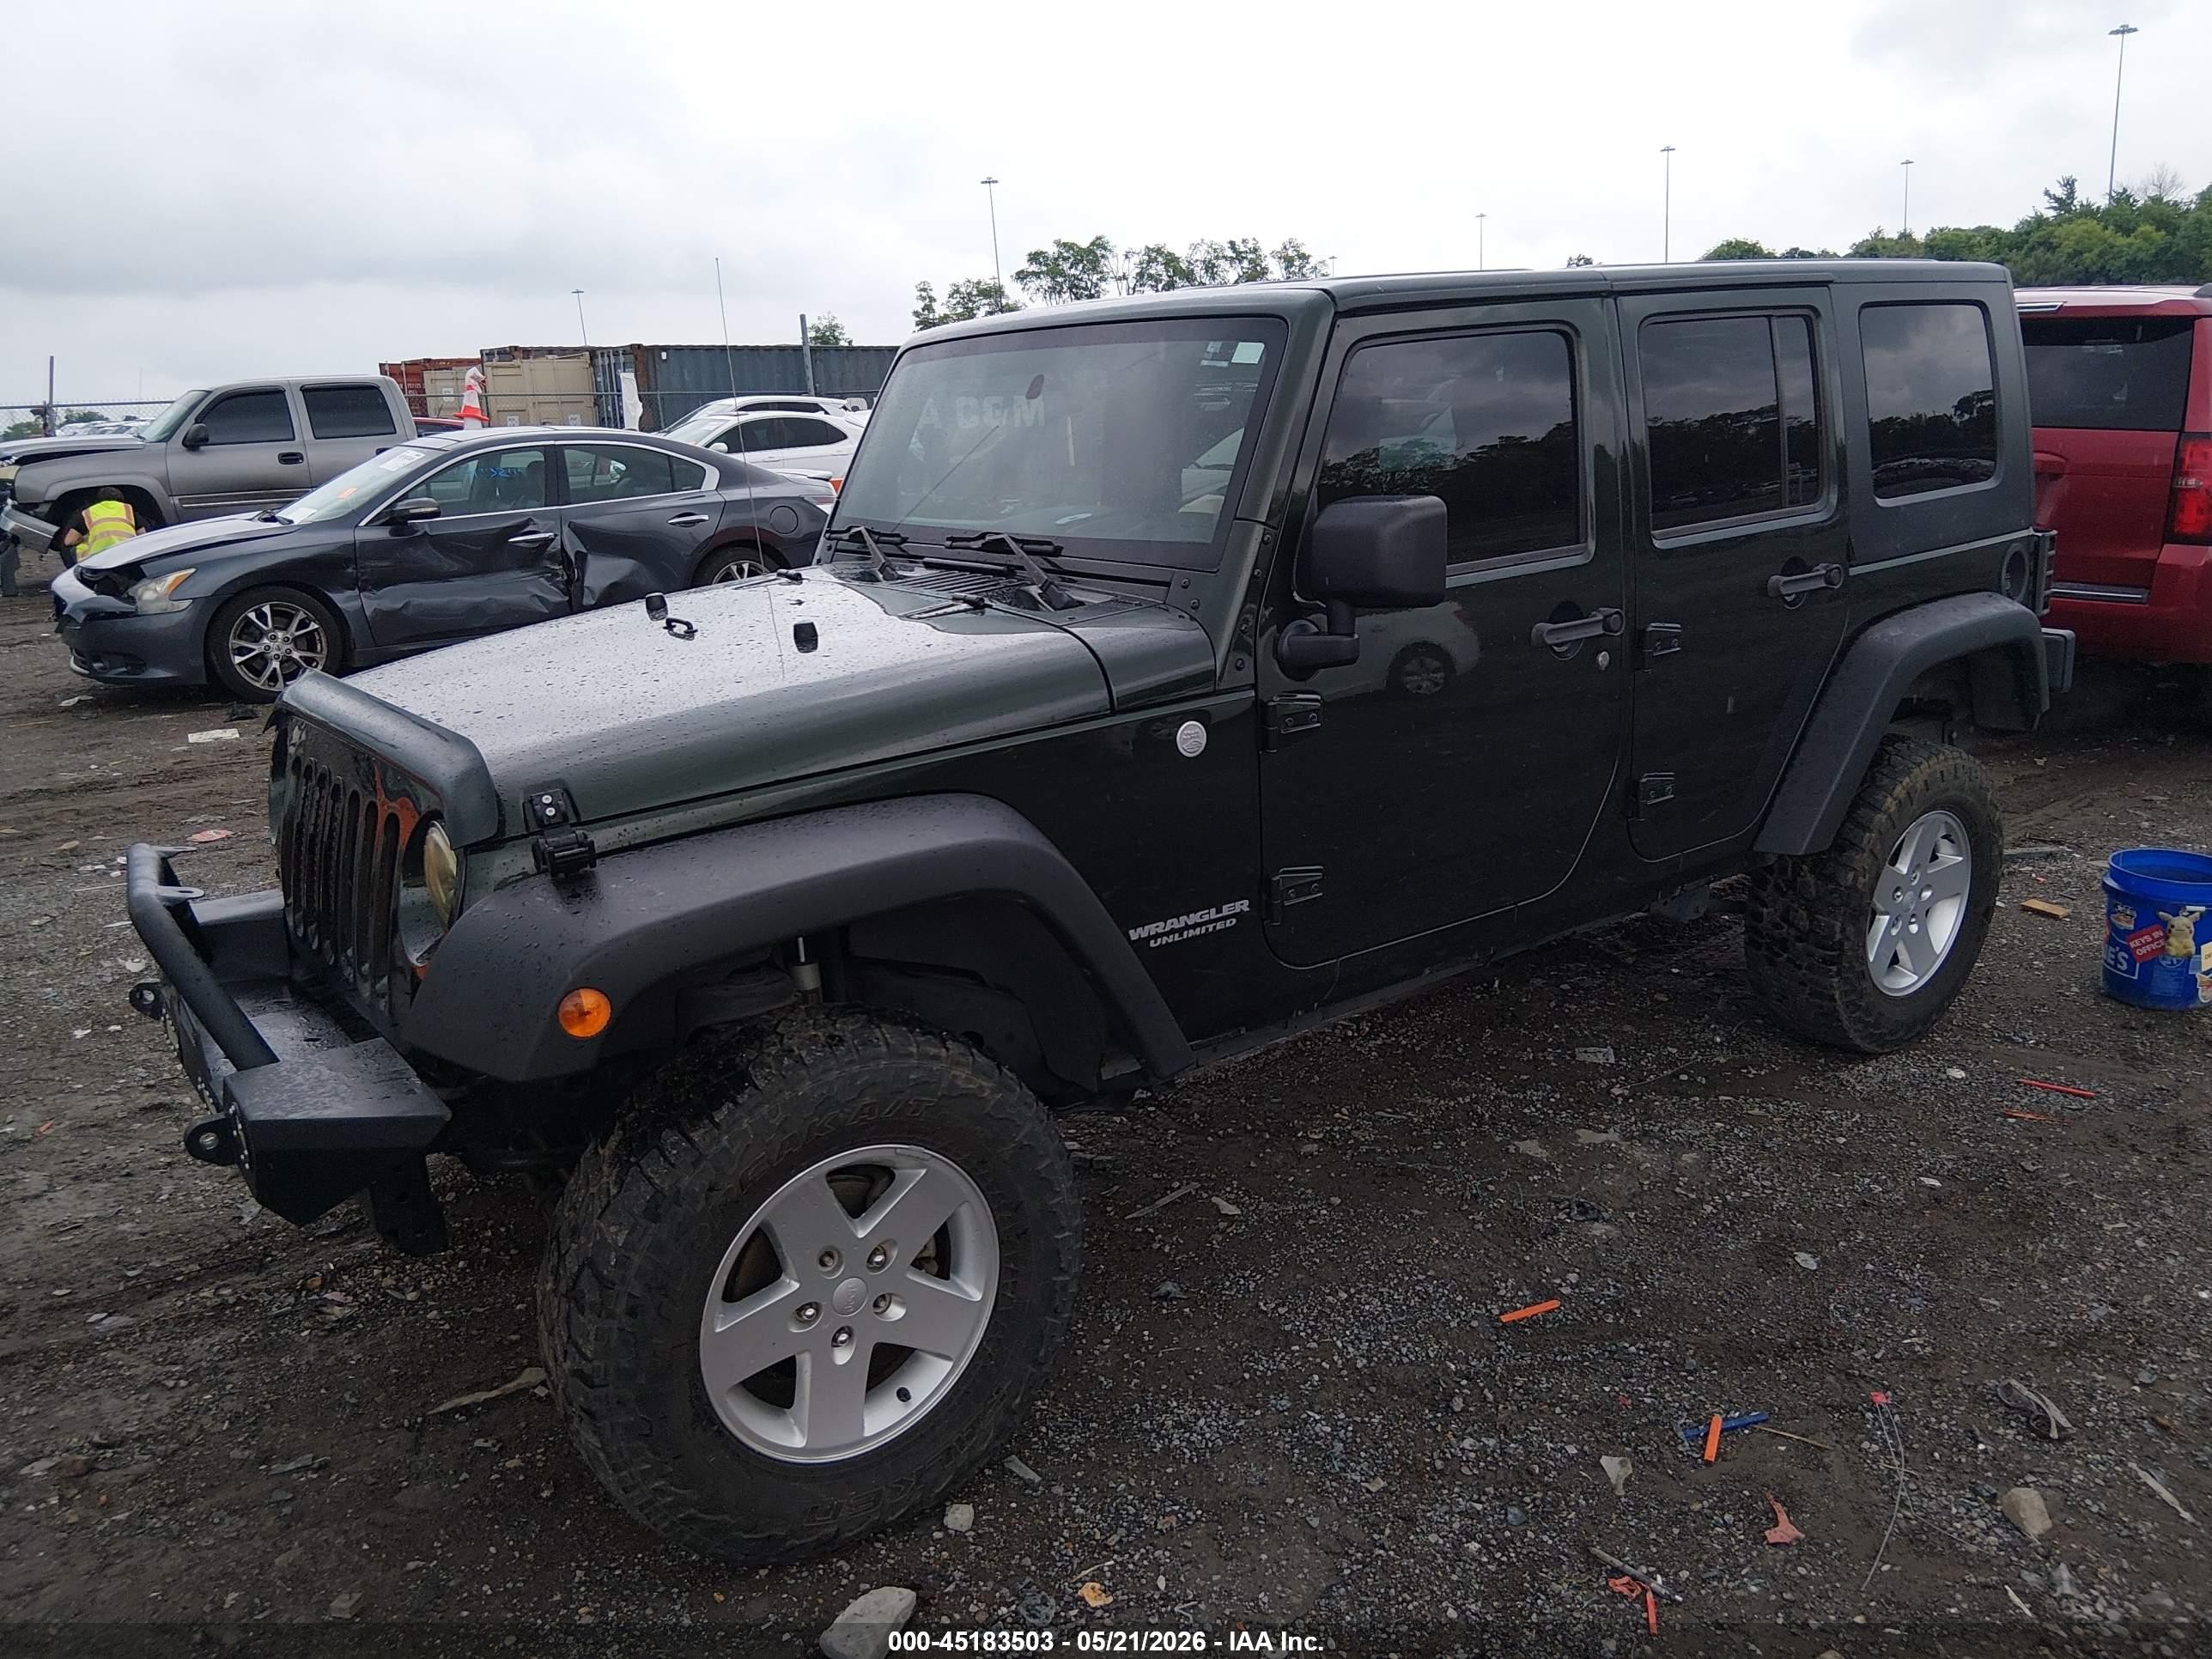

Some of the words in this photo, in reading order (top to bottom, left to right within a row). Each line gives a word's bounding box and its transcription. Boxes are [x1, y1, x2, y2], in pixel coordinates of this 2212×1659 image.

[1128, 899, 1250, 940] WRANGLER
[1149, 918, 1237, 948] UNLIMITED
[2130, 935, 2152, 948] KEYS
